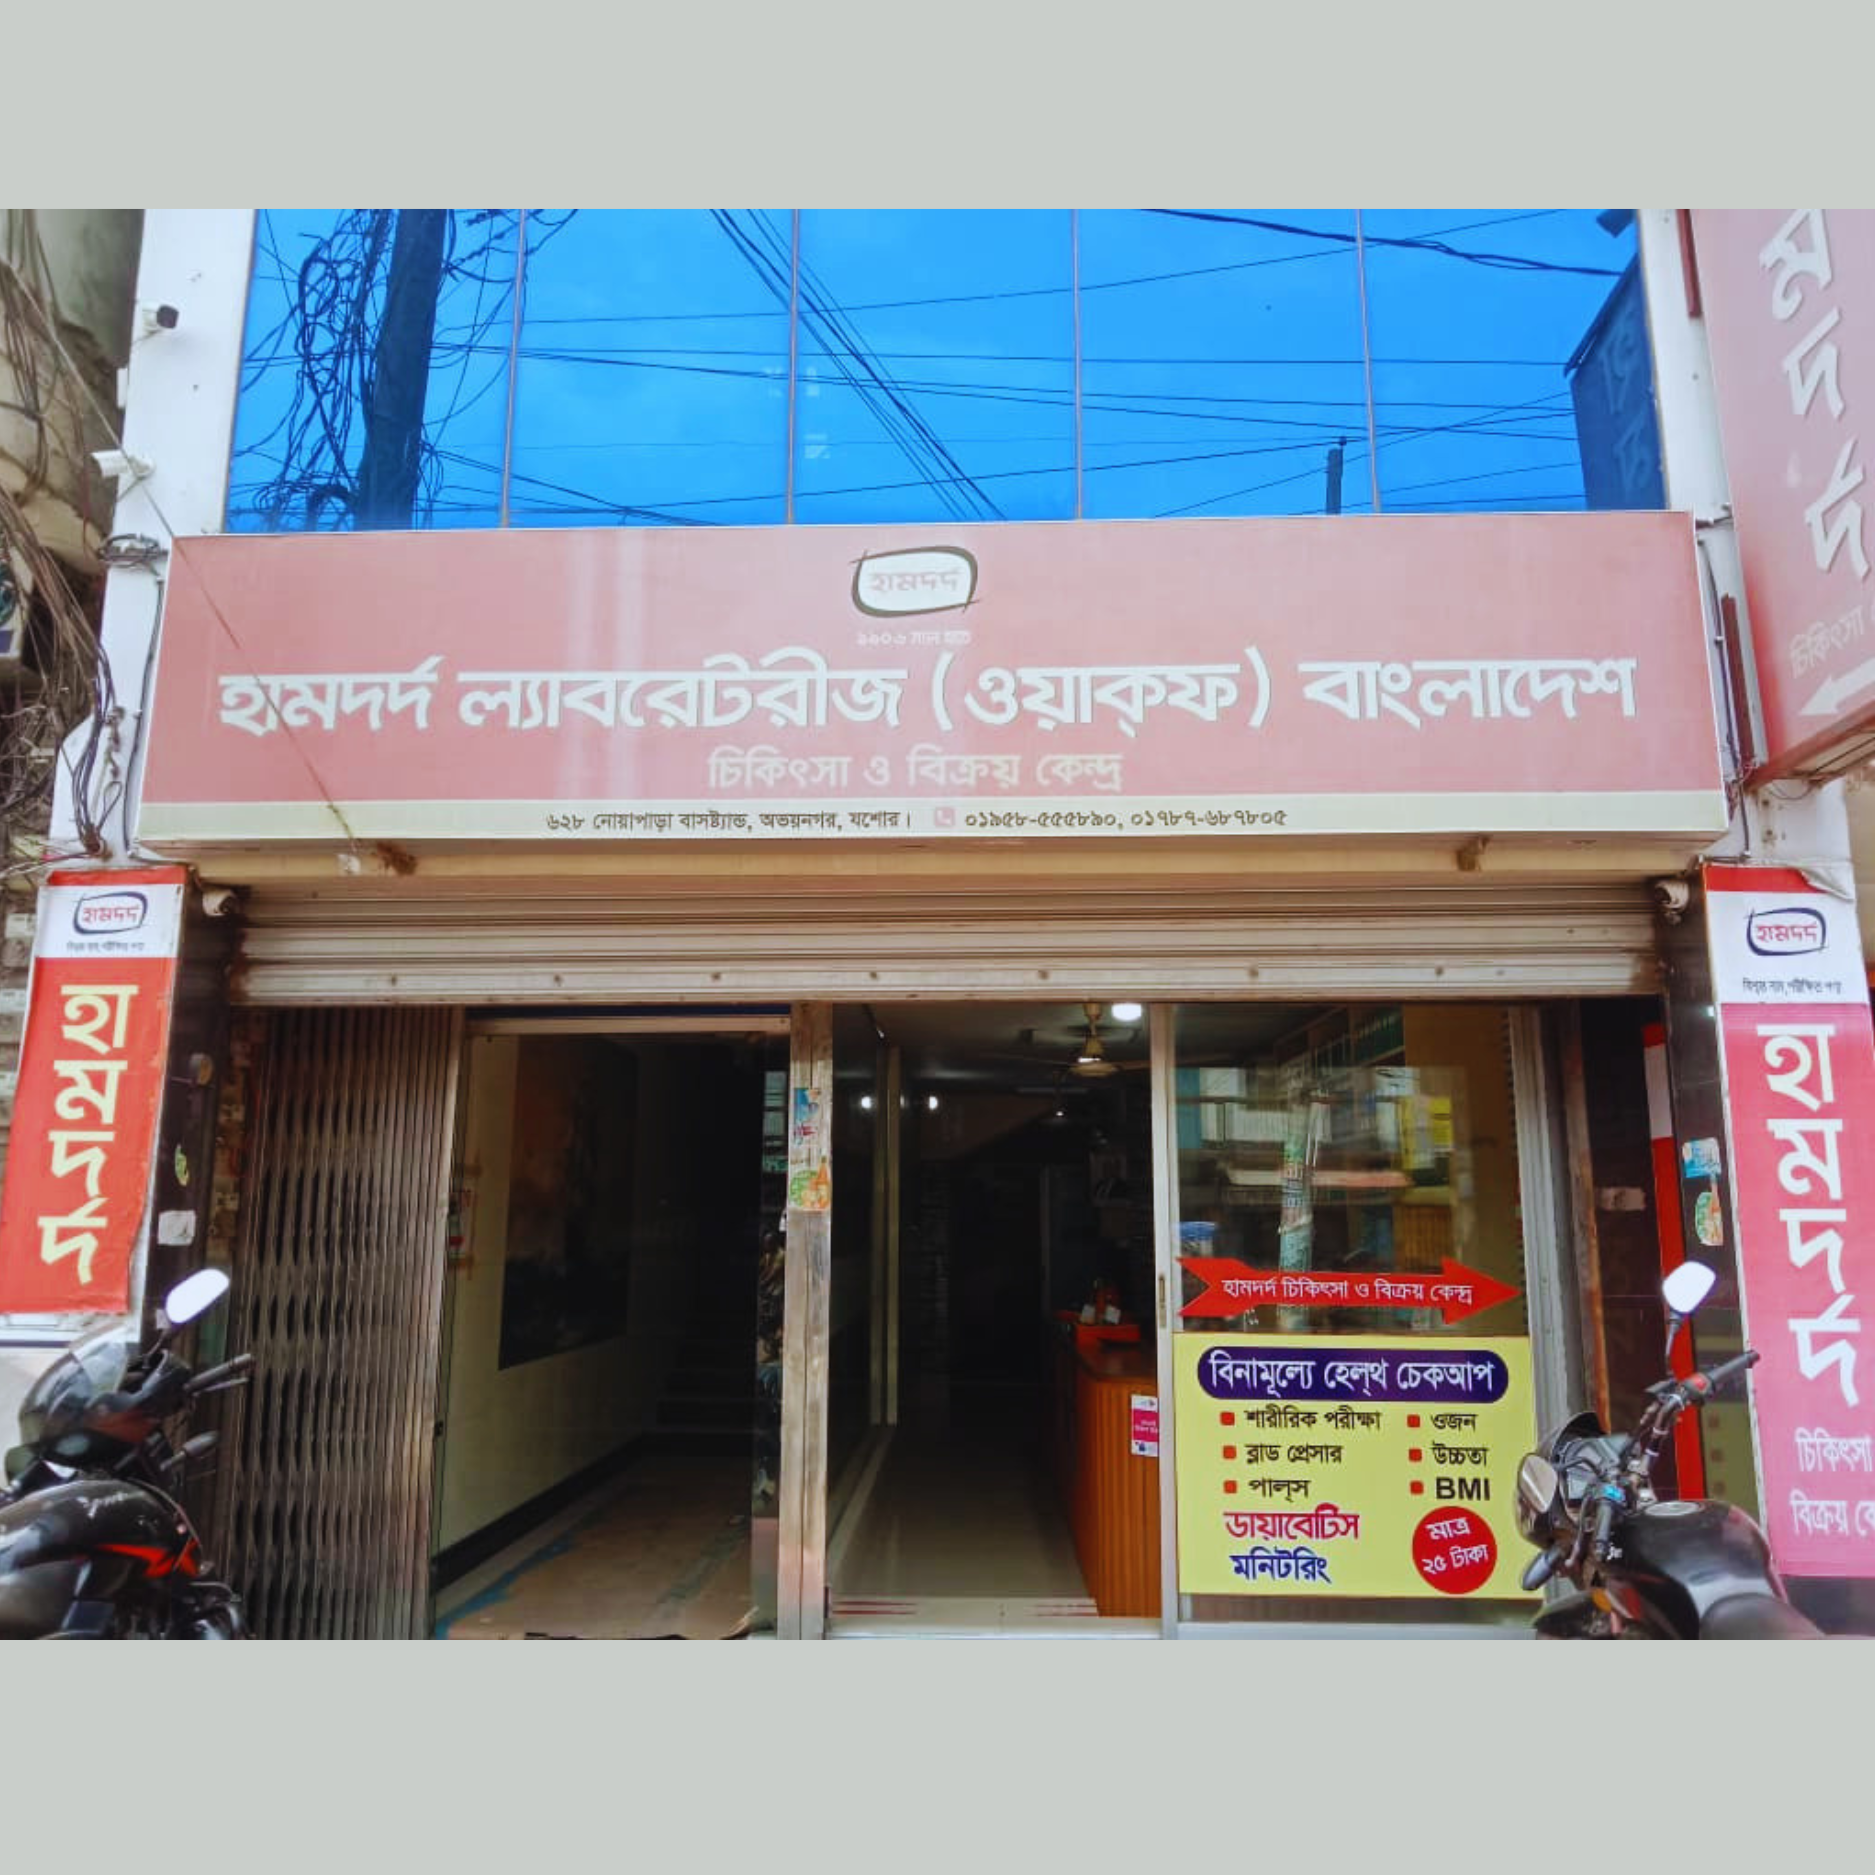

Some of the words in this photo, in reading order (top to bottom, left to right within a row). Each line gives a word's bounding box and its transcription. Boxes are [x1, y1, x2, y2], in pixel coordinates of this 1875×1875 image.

[218, 654, 443, 737] হামদর্দ
[457, 646, 908, 728] ল্যাবরেটরীজ
[1298, 657, 1637, 730] বাংলাদেশ
[706, 744, 852, 789] চিকিৎসা
[862, 756, 891, 788] ও
[905, 742, 1021, 789] বিক্রয়
[1036, 752, 1124, 792] কেন্দ্র
[546, 814, 586, 832] ৬২৮
[592, 811, 674, 833] নোয়াপাড়া
[758, 810, 843, 832] অভয়নগর,
[1131, 808, 1289, 827] ০১৭৮৭-৬৮৭৮০৫
[82, 904, 142, 925] হামদর্দ
[1755, 921, 1818, 943] হামদর্দ
[1221, 1278, 1276, 1298] হামদর্দ
[1281, 1277, 1348, 1299] চিকিৎসা
[1354, 1281, 1370, 1298] ও
[1373, 1278, 1425, 1300] বিক্রয়
[1430, 1283, 1473, 1305] কেন্দ্র
[1208, 1349, 1316, 1398] বিনামূল্যে
[1396, 1359, 1496, 1394] চেকআপ
[1244, 1404, 1319, 1429] শারীরিক
[1323, 1405, 1382, 1431] পরীক্ষা
[1430, 1413, 1477, 1432] ওজন
[1244, 1443, 1281, 1465] ব্লাড
[1287, 1443, 1343, 1464] প্রেসার
[1431, 1440, 1489, 1466] উচ্চতা
[1435, 1477, 1491, 1501] BMI
[1223, 1502, 1360, 1542] ডায়াবেটিস
[1788, 1487, 1850, 1537] বিক্রয়
[1425, 1516, 1472, 1541] মাত্র
[1229, 1544, 1332, 1584] মনিটরিং
[1421, 1555, 1447, 1575] ২৫
[1448, 1543, 1489, 1569] টাকা
